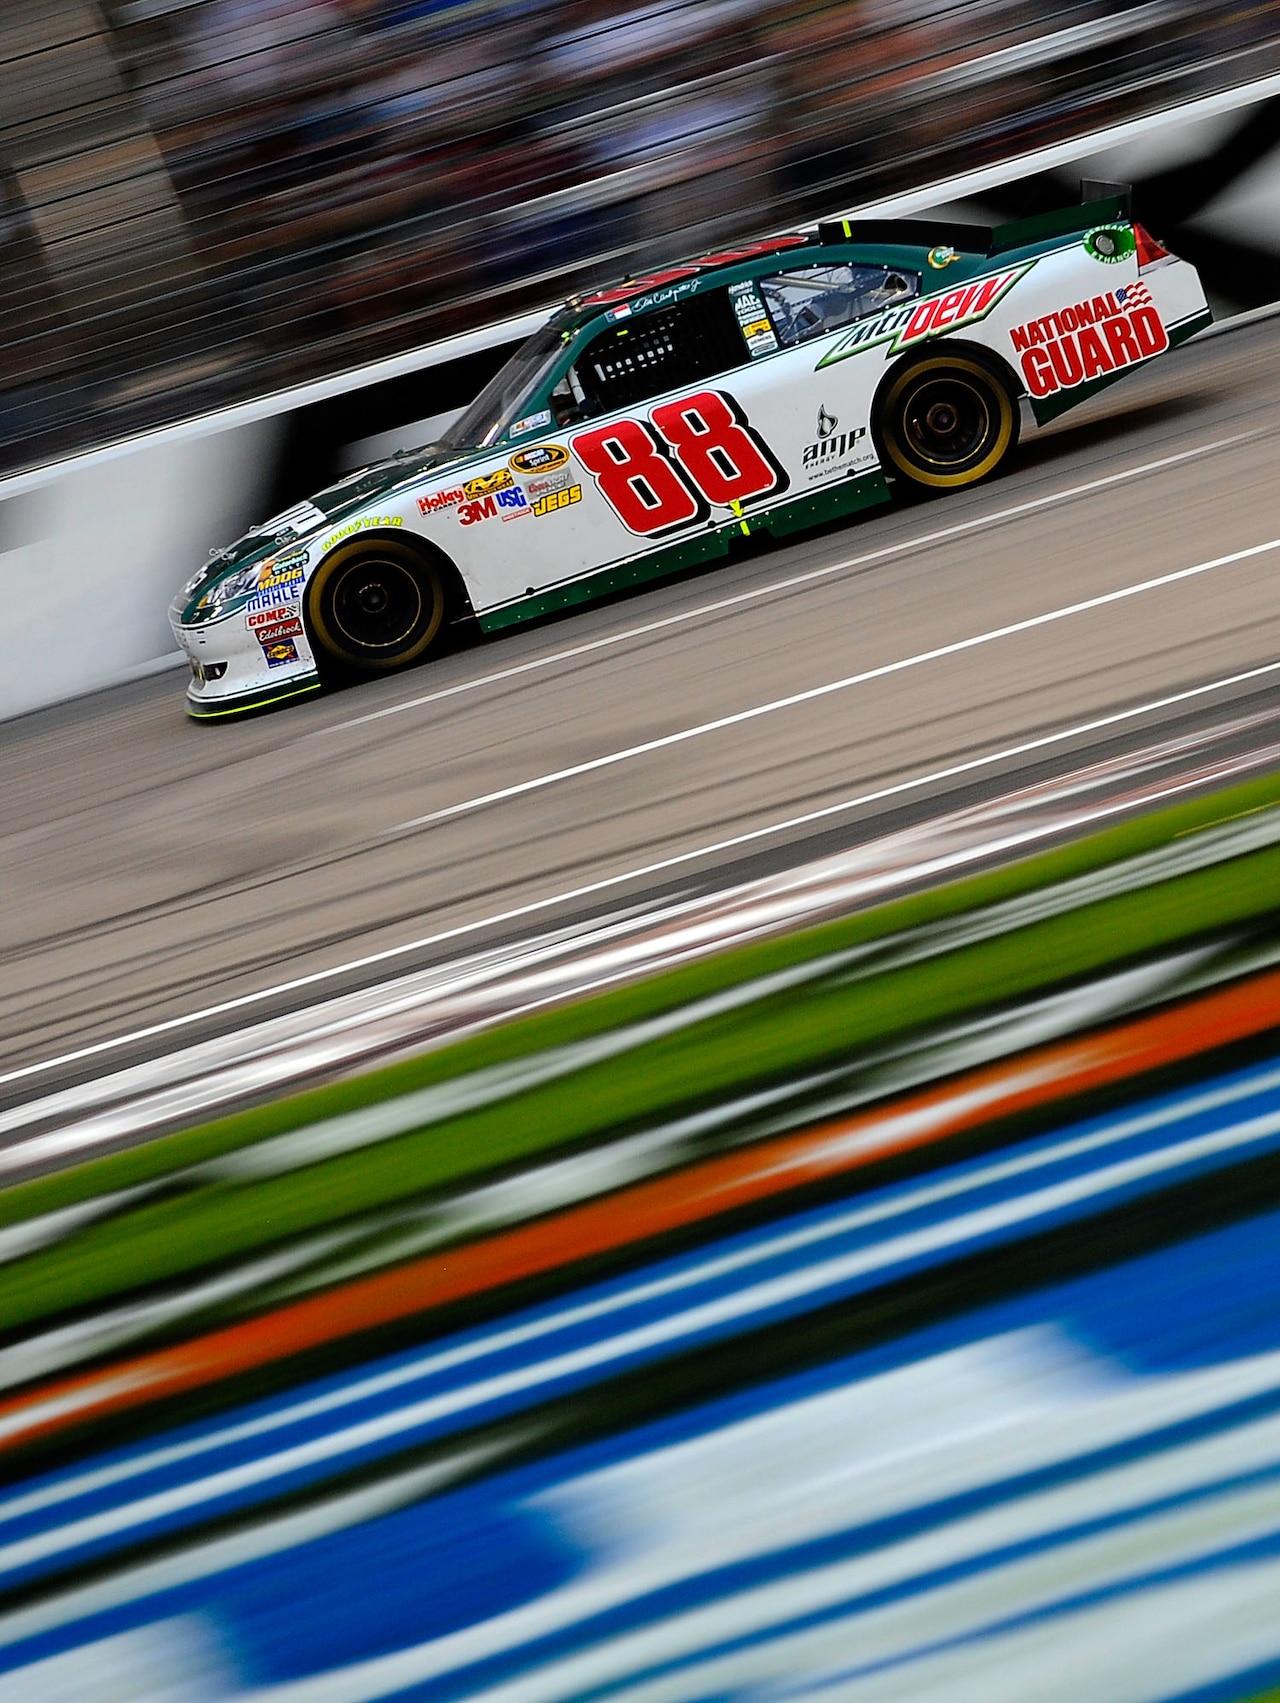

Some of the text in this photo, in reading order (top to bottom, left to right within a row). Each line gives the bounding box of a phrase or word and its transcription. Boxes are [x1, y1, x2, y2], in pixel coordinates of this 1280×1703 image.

[735, 294, 760, 311] MAC
[736, 303, 763, 316] TOOLS
[1009, 291, 1122, 353] NATIONAL
[1020, 306, 1168, 397] GUARD
[803, 427, 866, 464] amp
[529, 454, 551, 467] Sprint
[570, 390, 788, 537] 88
[418, 488, 465, 512] Holley
[495, 486, 527, 508] USG
[536, 485, 581, 516] JEGS
[457, 496, 498, 526] 3M
[322, 516, 403, 551] GOODYEAR
[258, 568, 303, 590] MOOG
[248, 585, 300, 612] MAHLE
[248, 607, 287, 627] COMP
[259, 622, 301, 641] Edelbrock
